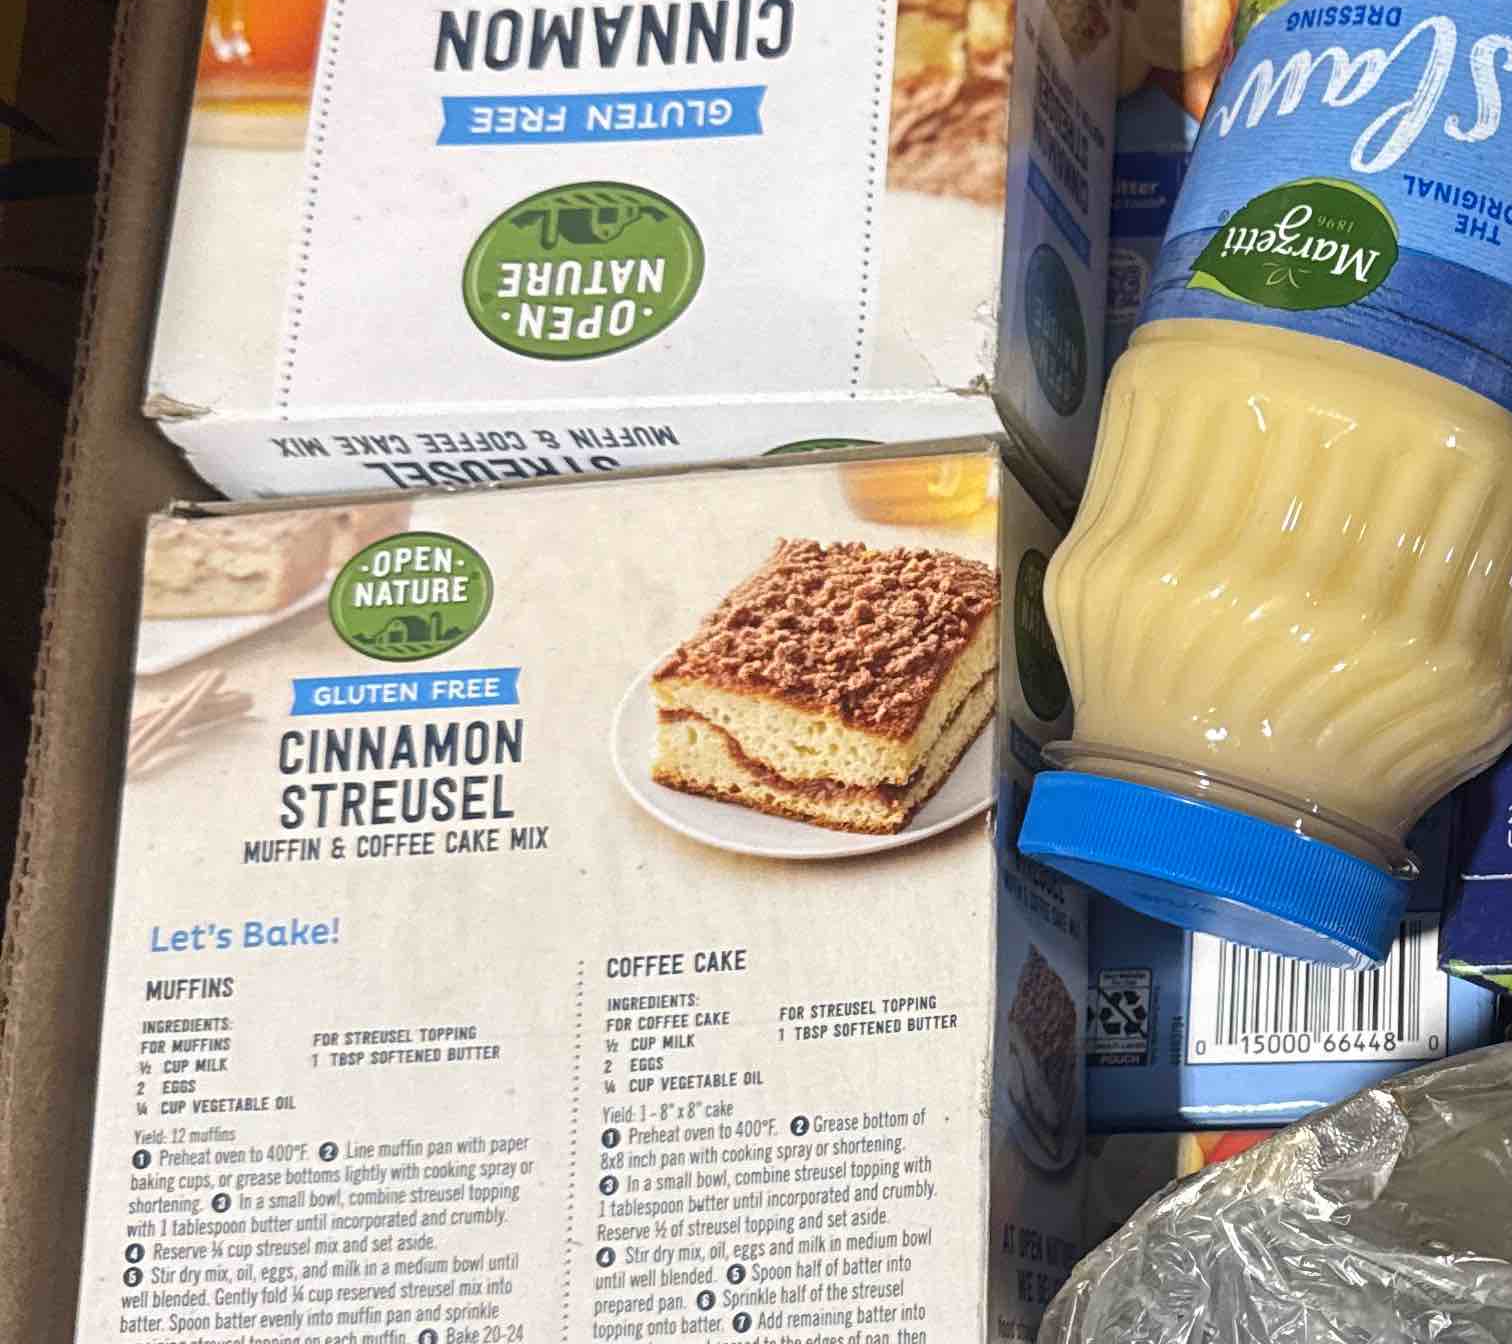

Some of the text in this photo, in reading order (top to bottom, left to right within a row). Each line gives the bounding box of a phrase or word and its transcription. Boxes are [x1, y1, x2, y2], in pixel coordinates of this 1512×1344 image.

[1285, 4, 1402, 31] DRESSING
[470, 98, 732, 133] GLUTEN FREE
[1317, 215, 1353, 232] 1896
[1454, 213, 1500, 245] THE
[1219, 203, 1380, 282] Marzetti
[497, 258, 664, 297] NATURE
[517, 299, 635, 340] OPEN
[271, 425, 679, 456] MUFFIN & COFFEE CAKE MIX
[372, 546, 451, 576] OPEN
[354, 575, 468, 606] NATURE
[313, 677, 500, 706] GLUTEN FREE
[278, 718, 522, 774] CINNAMON
[280, 774, 514, 829] STREUSEL
[243, 826, 548, 863] MUFFIN & COFFEE CAKE MIX
[151, 917, 339, 952] Let's Bake!
[606, 949, 746, 978] COFFEE CAKE
[146, 976, 233, 1000] MUFFINS
[779, 995, 936, 1020] FOR STREUSEL TOPPING
[1195, 1032, 1438, 1055] 0 15000 66448 0
